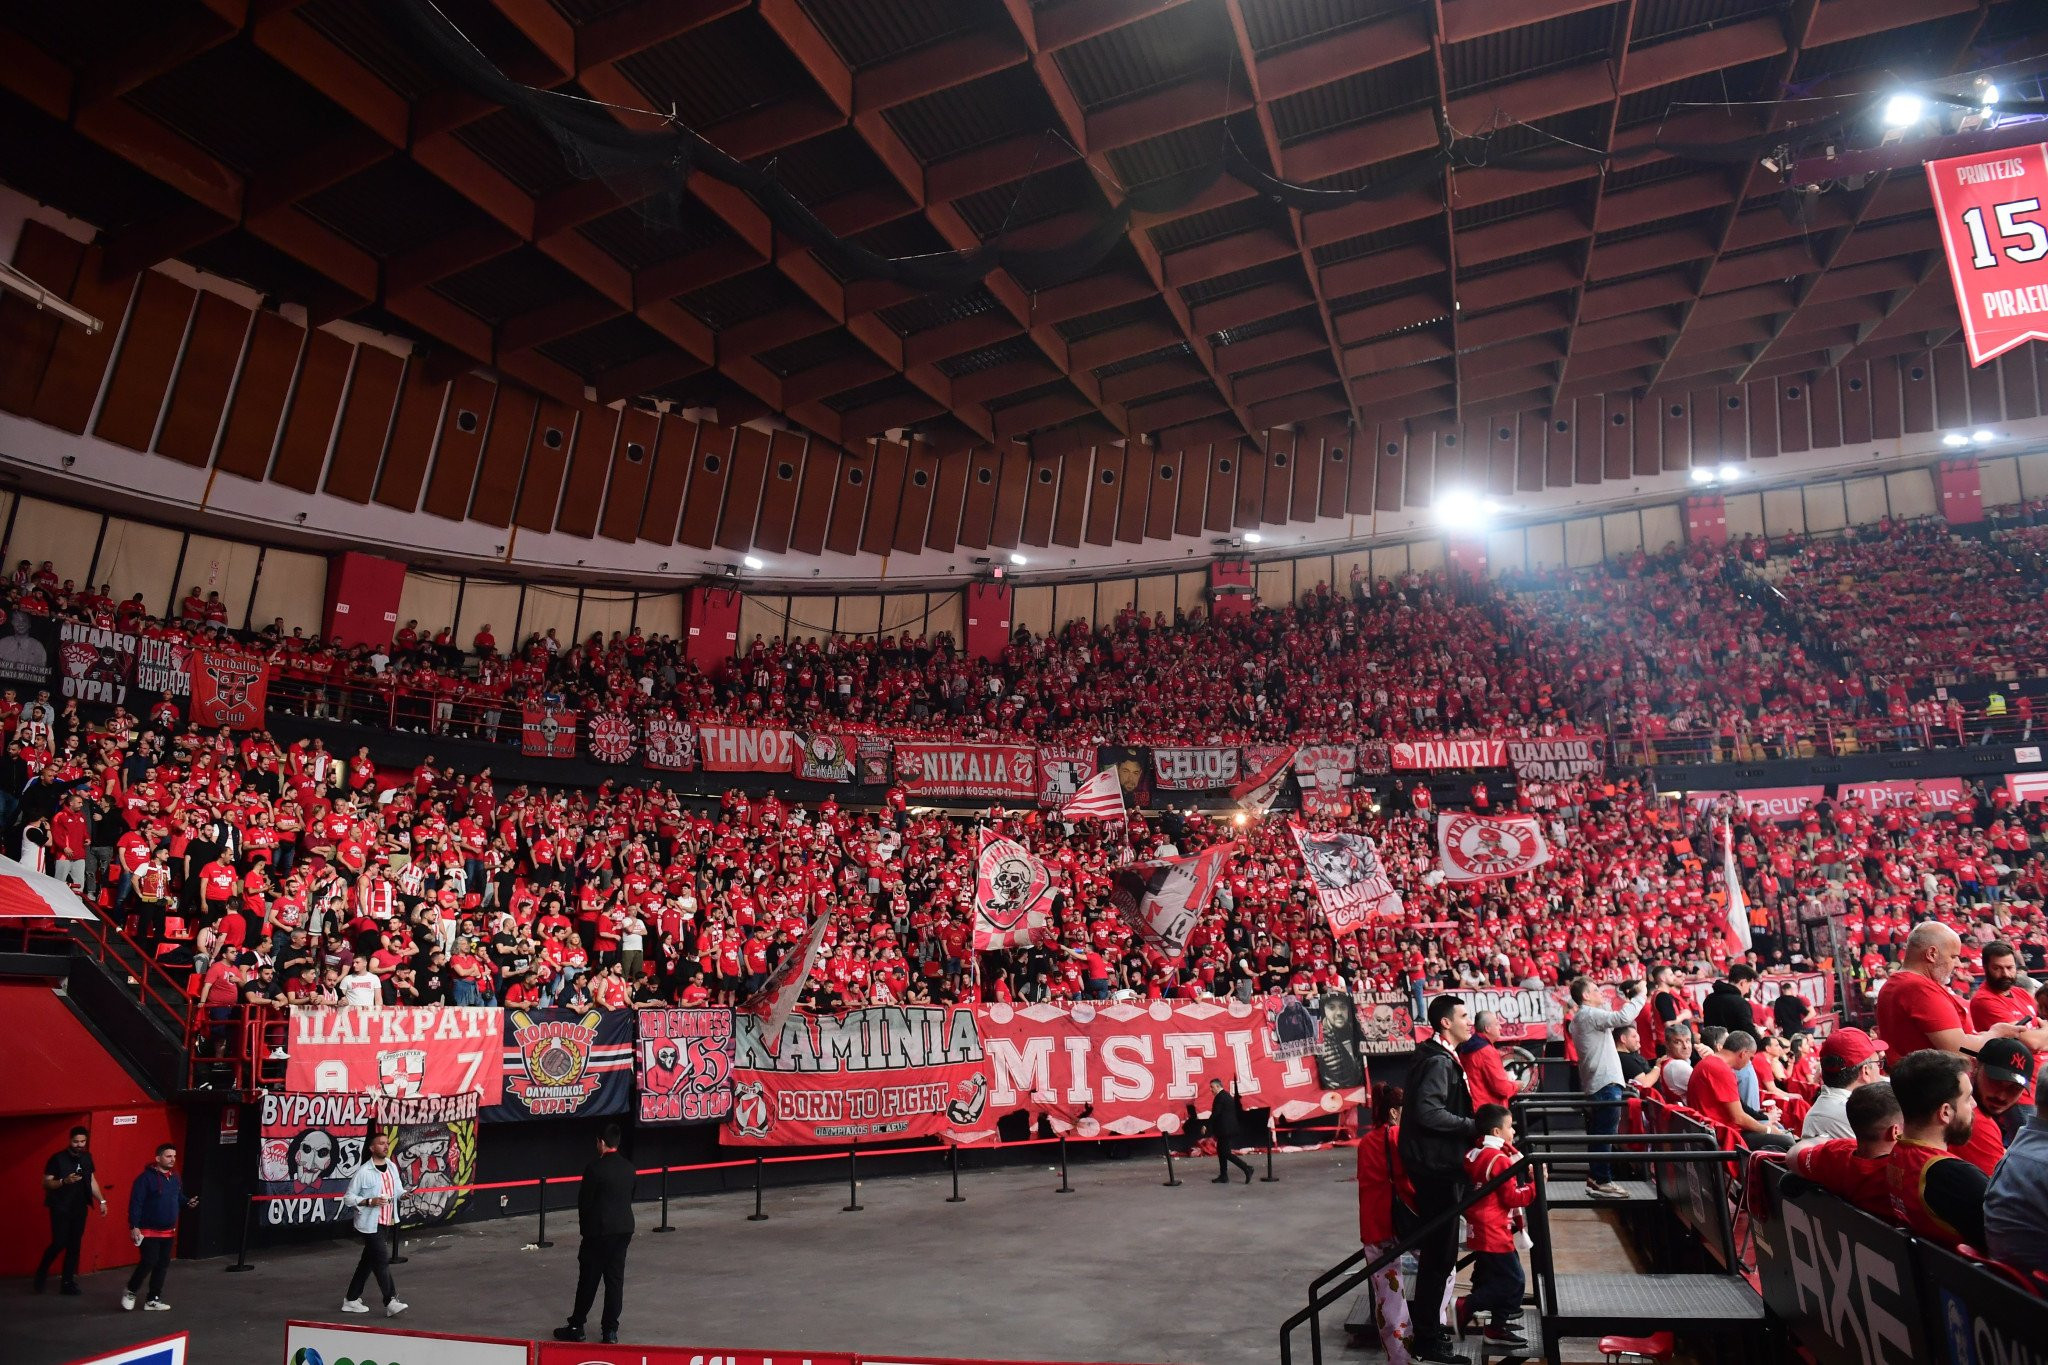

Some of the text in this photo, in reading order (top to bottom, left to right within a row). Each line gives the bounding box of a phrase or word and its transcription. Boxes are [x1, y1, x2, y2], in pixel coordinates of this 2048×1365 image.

[1956, 158, 2026, 186] PRINTEZIS
[1962, 198, 2048, 270] 15
[140, 639, 171, 667] ΑΓΙΑ
[204, 653, 262, 673] Koridallos
[62, 676, 126, 705] ΘΥΡΑ 7
[138, 666, 191, 696] ΒΑΡΒΑΡΑ
[215, 709, 245, 722] Club
[649, 749, 681, 767] ΘΥΡΑ
[700, 728, 795, 764] ΤΗΝΟΣ
[1414, 740, 1505, 768] ΓΑΛΑΤΣΙ 7
[1508, 741, 1588, 762] ΠΑΛΑΙΟ
[922, 752, 1008, 782] ΝΙΚΑΙΑ
[1154, 749, 1237, 780] CHIOS
[921, 786, 984, 796] ΟΛΥΜΠΙΑΚΟΣ
[297, 1005, 498, 1045] ΠΑΓΚΡΑΤΙ
[512, 1021, 598, 1046] ΚΟΛΩΝΟΣ
[639, 1009, 732, 1038] RED SICKNESS
[734, 1006, 984, 1072] KAMINIA
[1359, 1040, 1416, 1053] OLYMPIAKOS
[457, 1051, 484, 1094] 7
[525, 1083, 585, 1098] ΟΛΥΜΠΙΑΚΟΣ
[778, 1082, 948, 1121] BORN TO FIGHT
[262, 1095, 371, 1126] ΒΥΡΩΝΑΣ
[377, 1093, 479, 1125] ΚΑΙΣΑΡΙΑΝΗ
[641, 1091, 732, 1120] NON STOP
[814, 1122, 908, 1137] OLYMPIAKOS PIAEUS
[268, 1197, 327, 1225] ΘΥΡΑ
